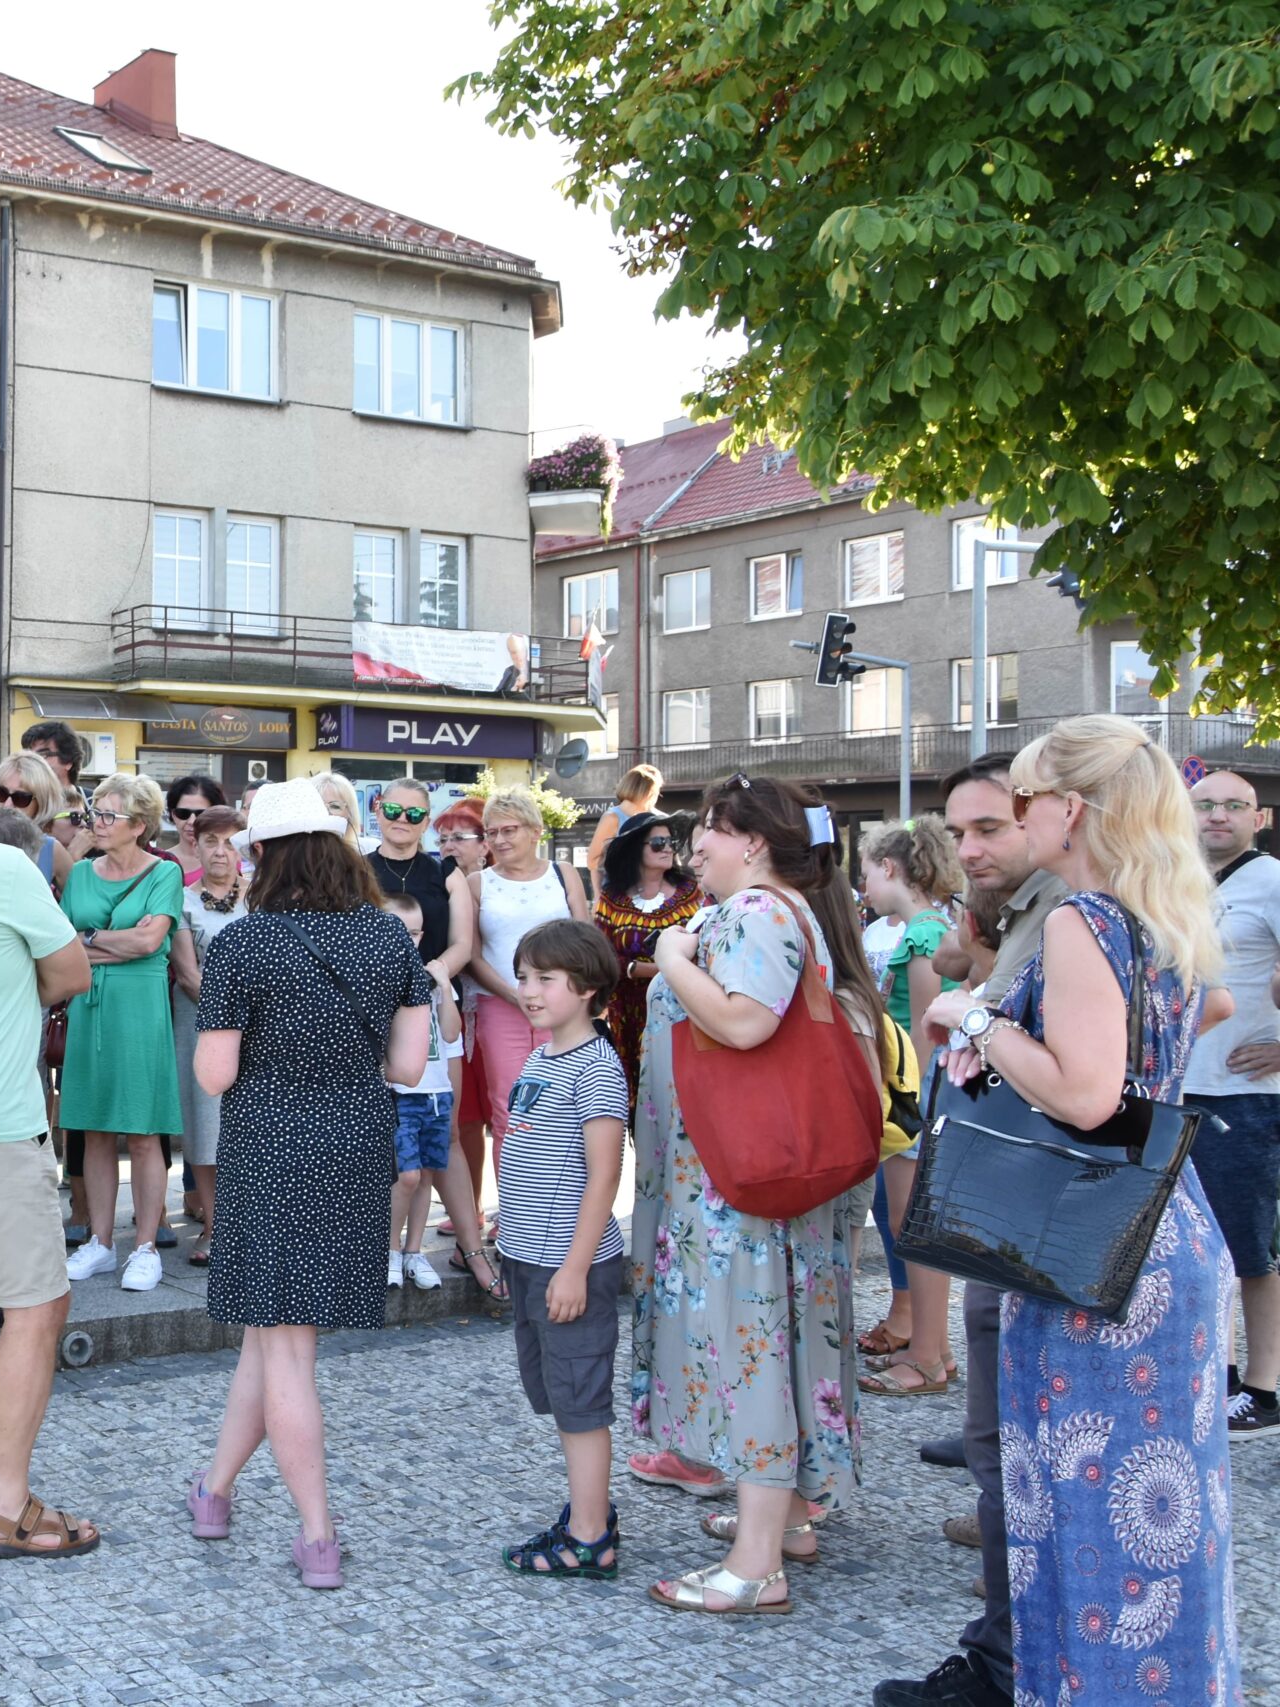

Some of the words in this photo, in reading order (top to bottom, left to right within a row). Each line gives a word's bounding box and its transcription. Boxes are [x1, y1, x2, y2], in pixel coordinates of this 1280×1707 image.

[203, 720, 248, 733] SANTOS
[259, 722, 291, 734] LODY
[387, 720, 482, 747] PLAY
[318, 735, 339, 746] PLAY
[575, 802, 615, 814] OWNIA
